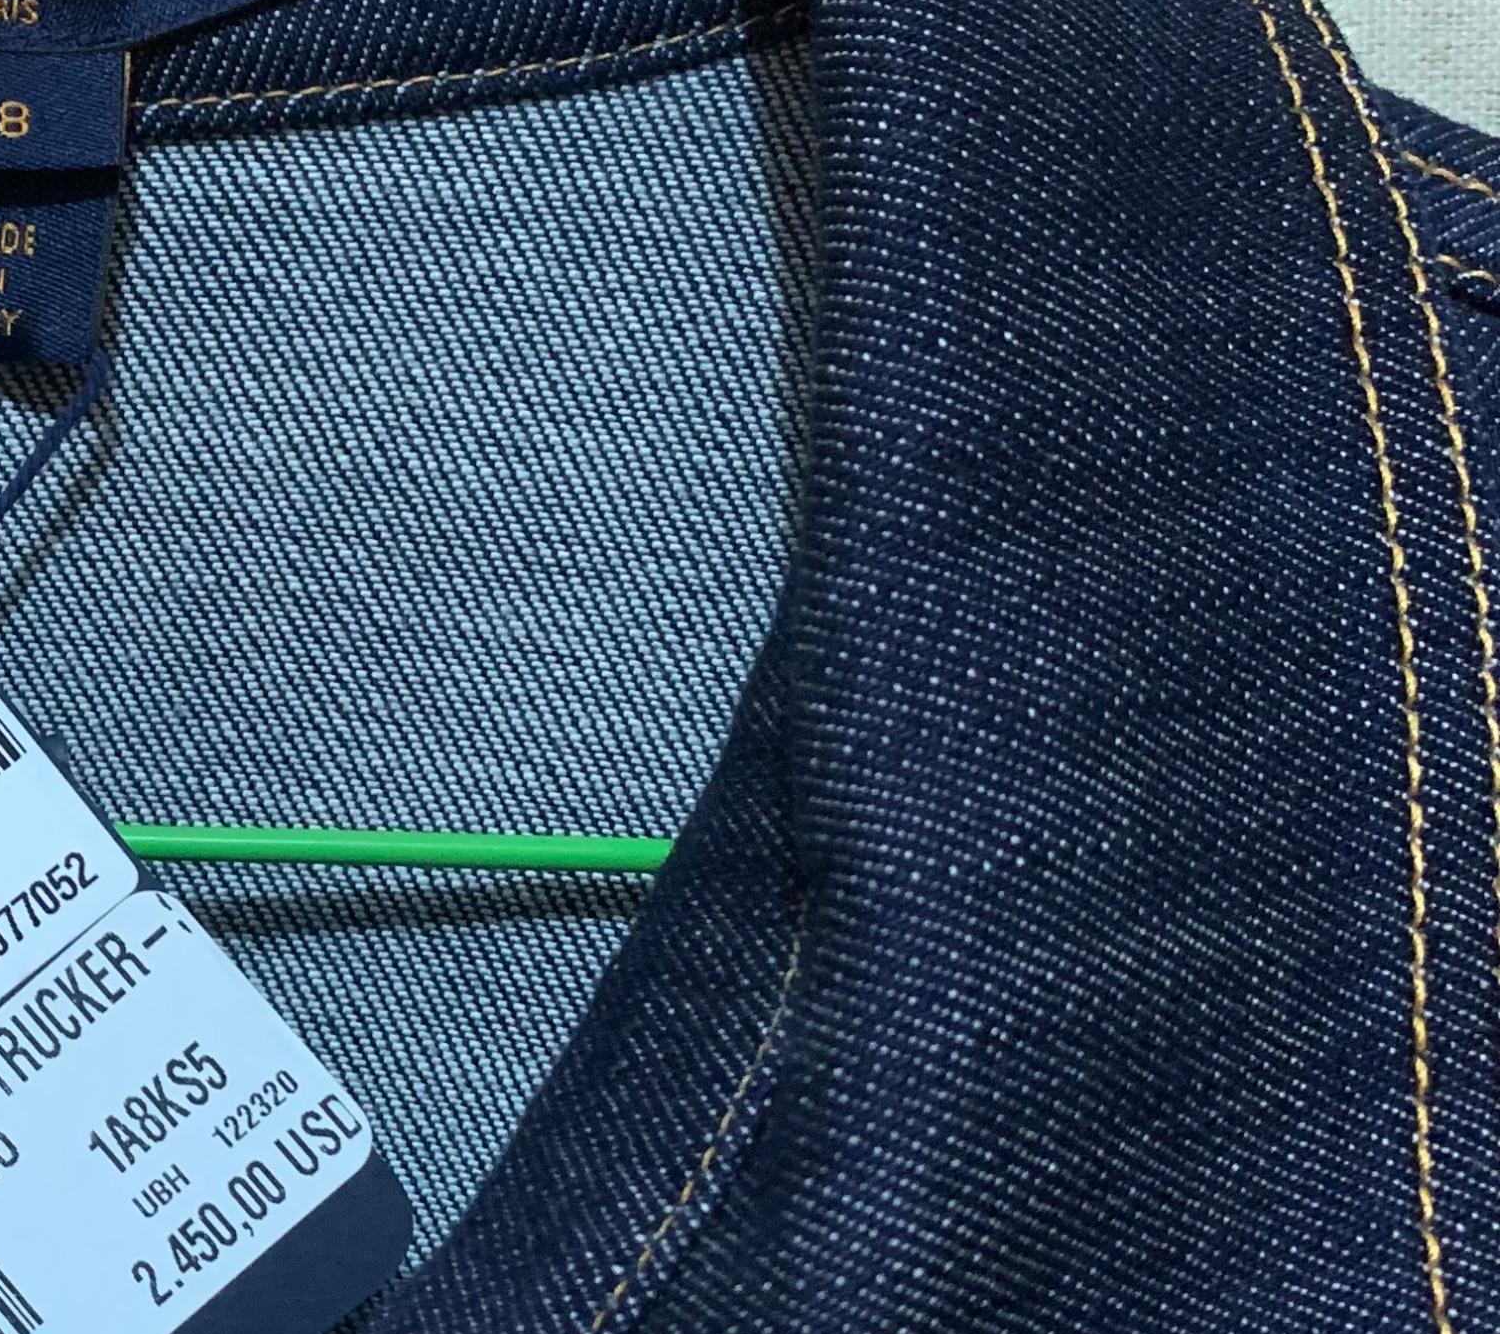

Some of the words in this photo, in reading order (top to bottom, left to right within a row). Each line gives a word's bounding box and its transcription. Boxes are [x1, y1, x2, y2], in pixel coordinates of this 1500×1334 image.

[89, 1040, 227, 1172] 1A8KS5
[132, 1163, 191, 1217] UBH
[212, 1070, 298, 1148] 122320
[132, 1160, 286, 1306] 2.450,00
[274, 1094, 362, 1175] USD
